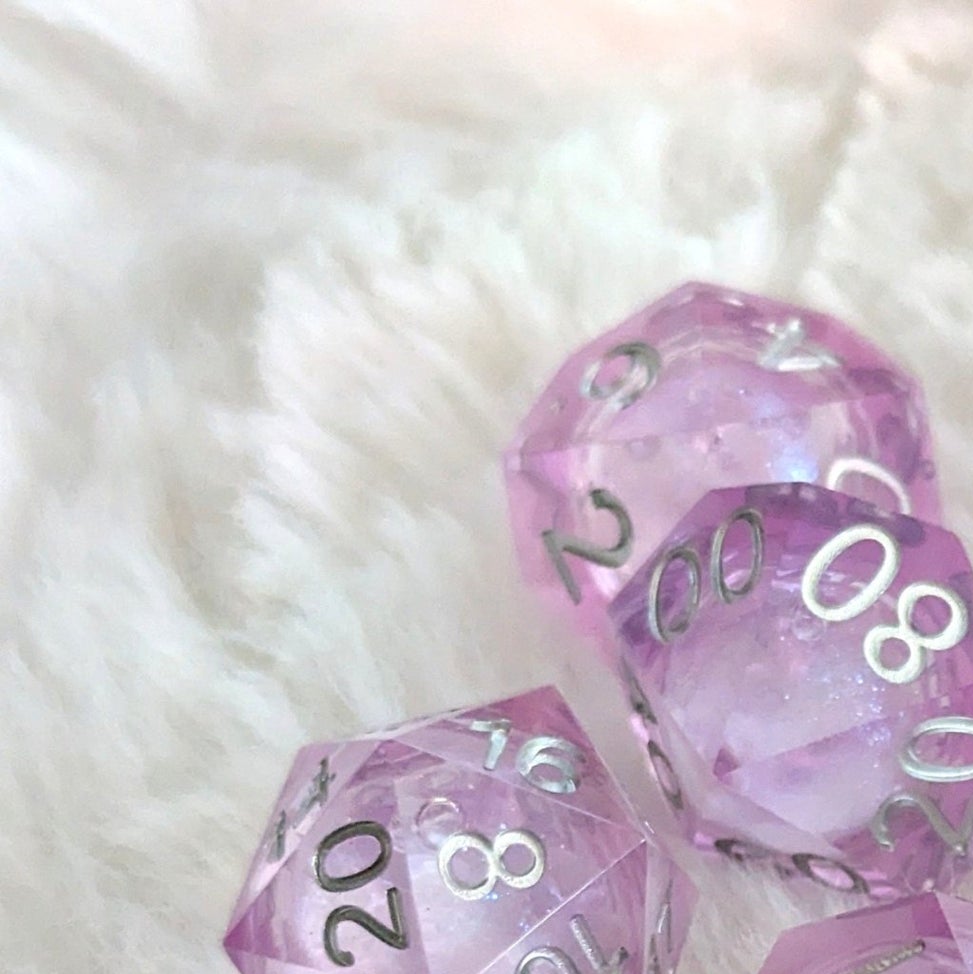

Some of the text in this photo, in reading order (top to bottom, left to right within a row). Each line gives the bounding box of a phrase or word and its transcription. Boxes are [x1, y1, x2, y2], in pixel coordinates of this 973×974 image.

[542, 488, 634, 604] 2
[801, 523, 969, 684] 80
[470, 719, 586, 794] 16
[312, 820, 409, 968] 20
[438, 829, 546, 900] 8
